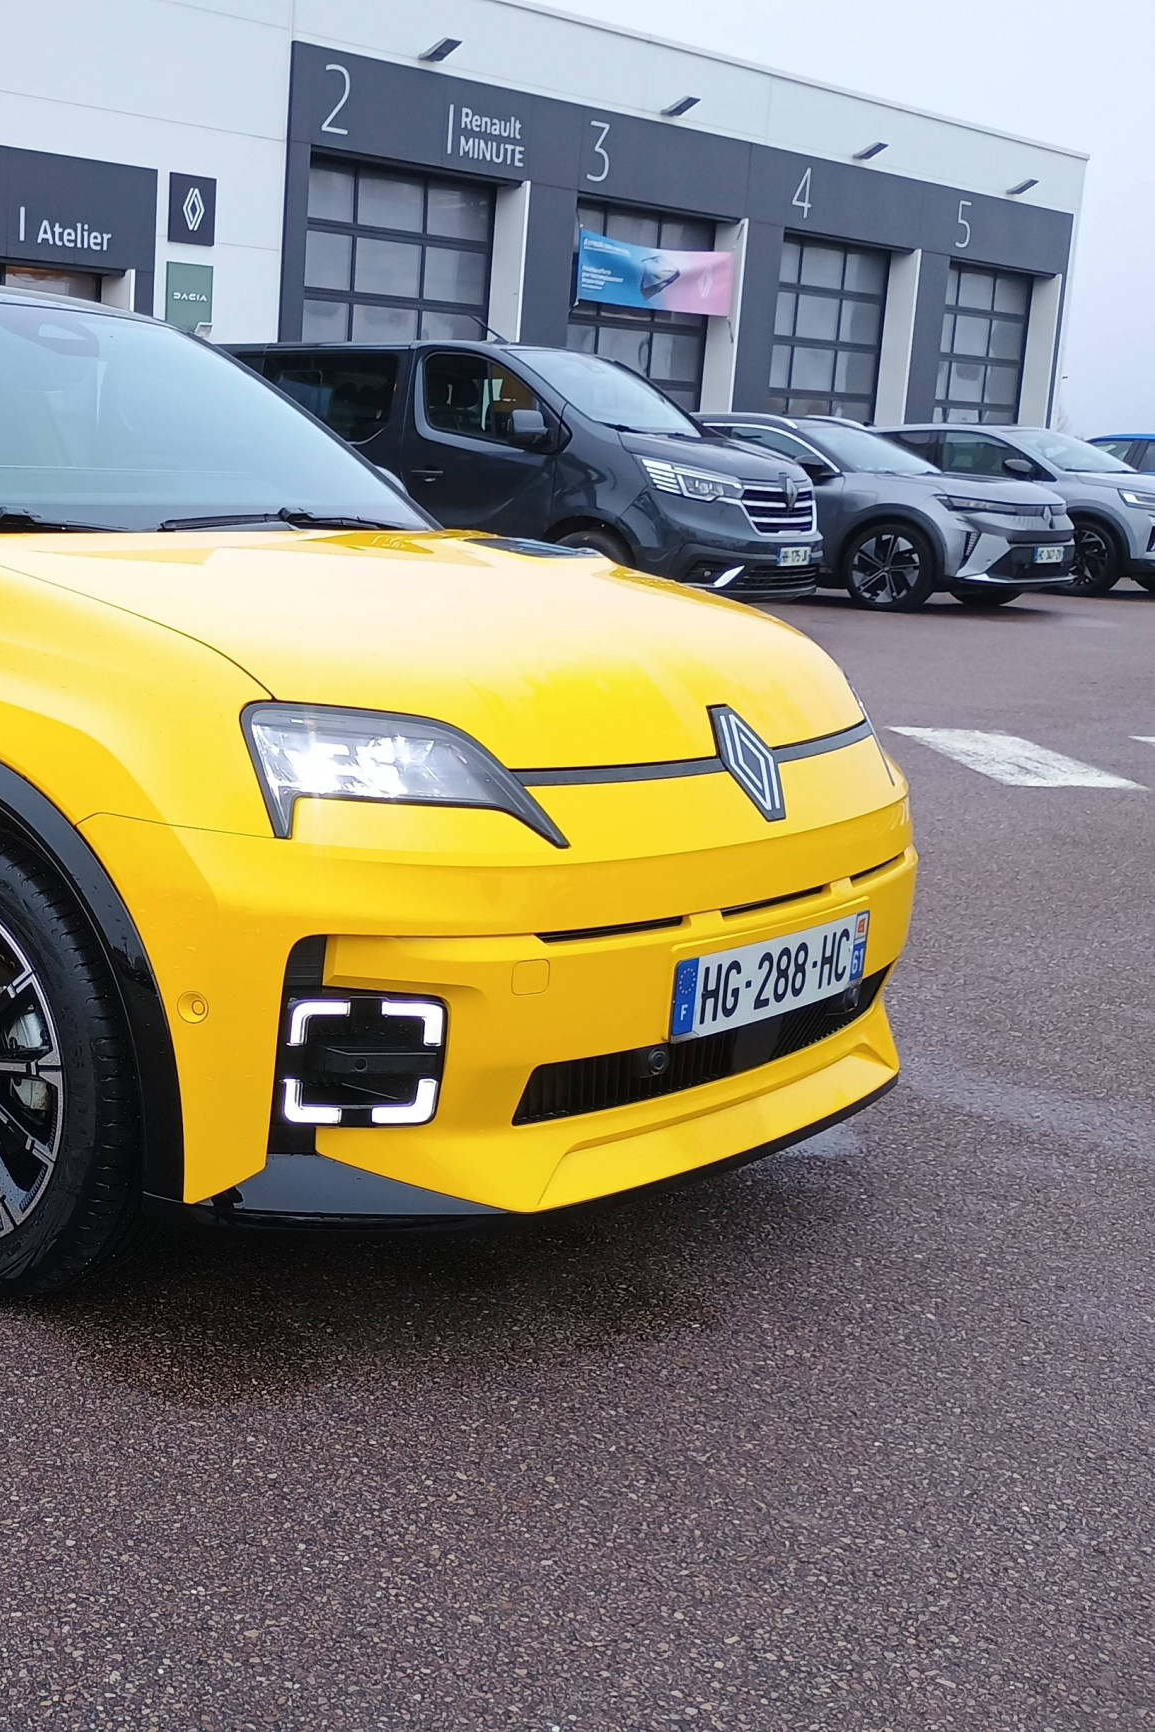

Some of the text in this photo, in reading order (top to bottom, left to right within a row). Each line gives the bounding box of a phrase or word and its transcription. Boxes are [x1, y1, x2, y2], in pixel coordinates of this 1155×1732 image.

[320, 63, 352, 136] 2
[461, 107, 522, 139] Renault
[459, 135, 525, 167] MINUTE
[585, 120, 611, 183] 3
[791, 166, 812, 219] 4
[36, 219, 112, 251] Atelier
[955, 200, 973, 249] 5
[173, 291, 208, 302] DACIA
[699, 928, 850, 1025] HG-288-HC
[851, 947, 864, 975] 61
[679, 1003, 689, 1021] F
